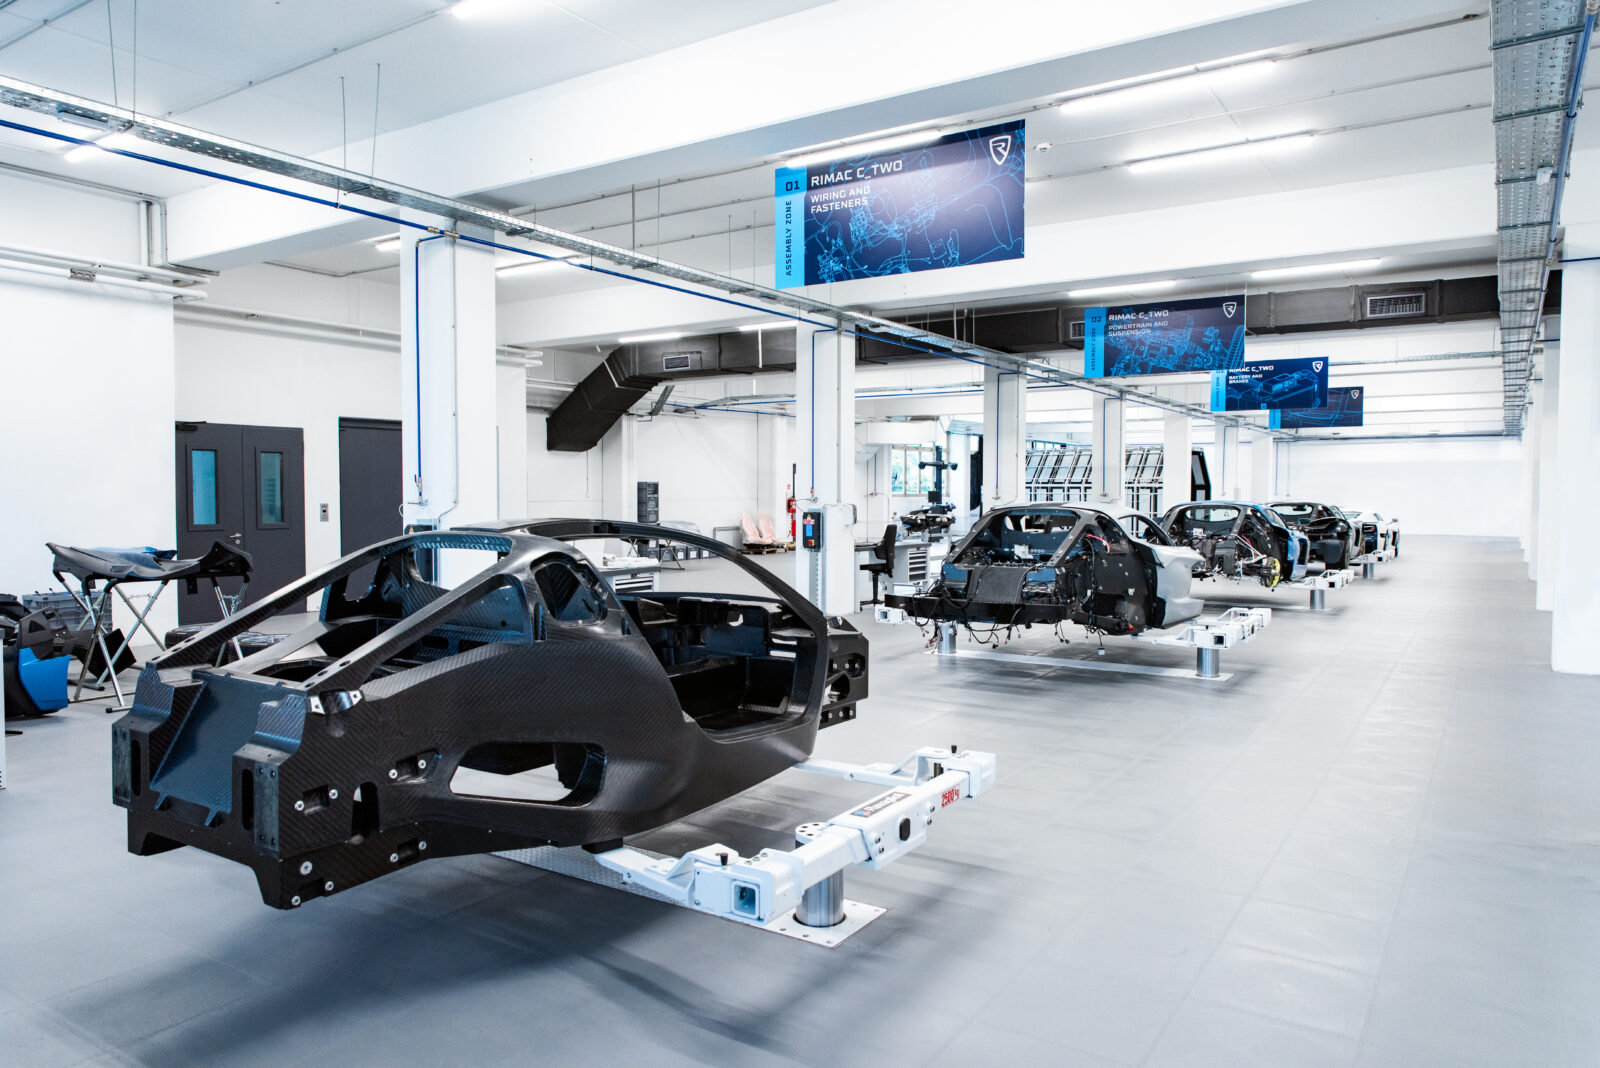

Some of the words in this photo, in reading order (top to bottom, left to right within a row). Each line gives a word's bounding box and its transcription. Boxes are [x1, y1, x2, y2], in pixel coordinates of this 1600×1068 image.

[811, 169, 853, 187] RIMAC
[857, 159, 903, 180] C_TWO
[785, 180, 800, 192] 01
[810, 189, 846, 204] WIRING
[849, 185, 871, 196] AND
[810, 196, 869, 214] FASTENERS
[1108, 312, 1137, 321] RIMAC
[1138, 309, 1169, 320] C_TWO
[1108, 322, 1153, 331] POWERTRAIN
[1153, 320, 1169, 328] AND
[1108, 328, 1151, 337] SUSPENSION
